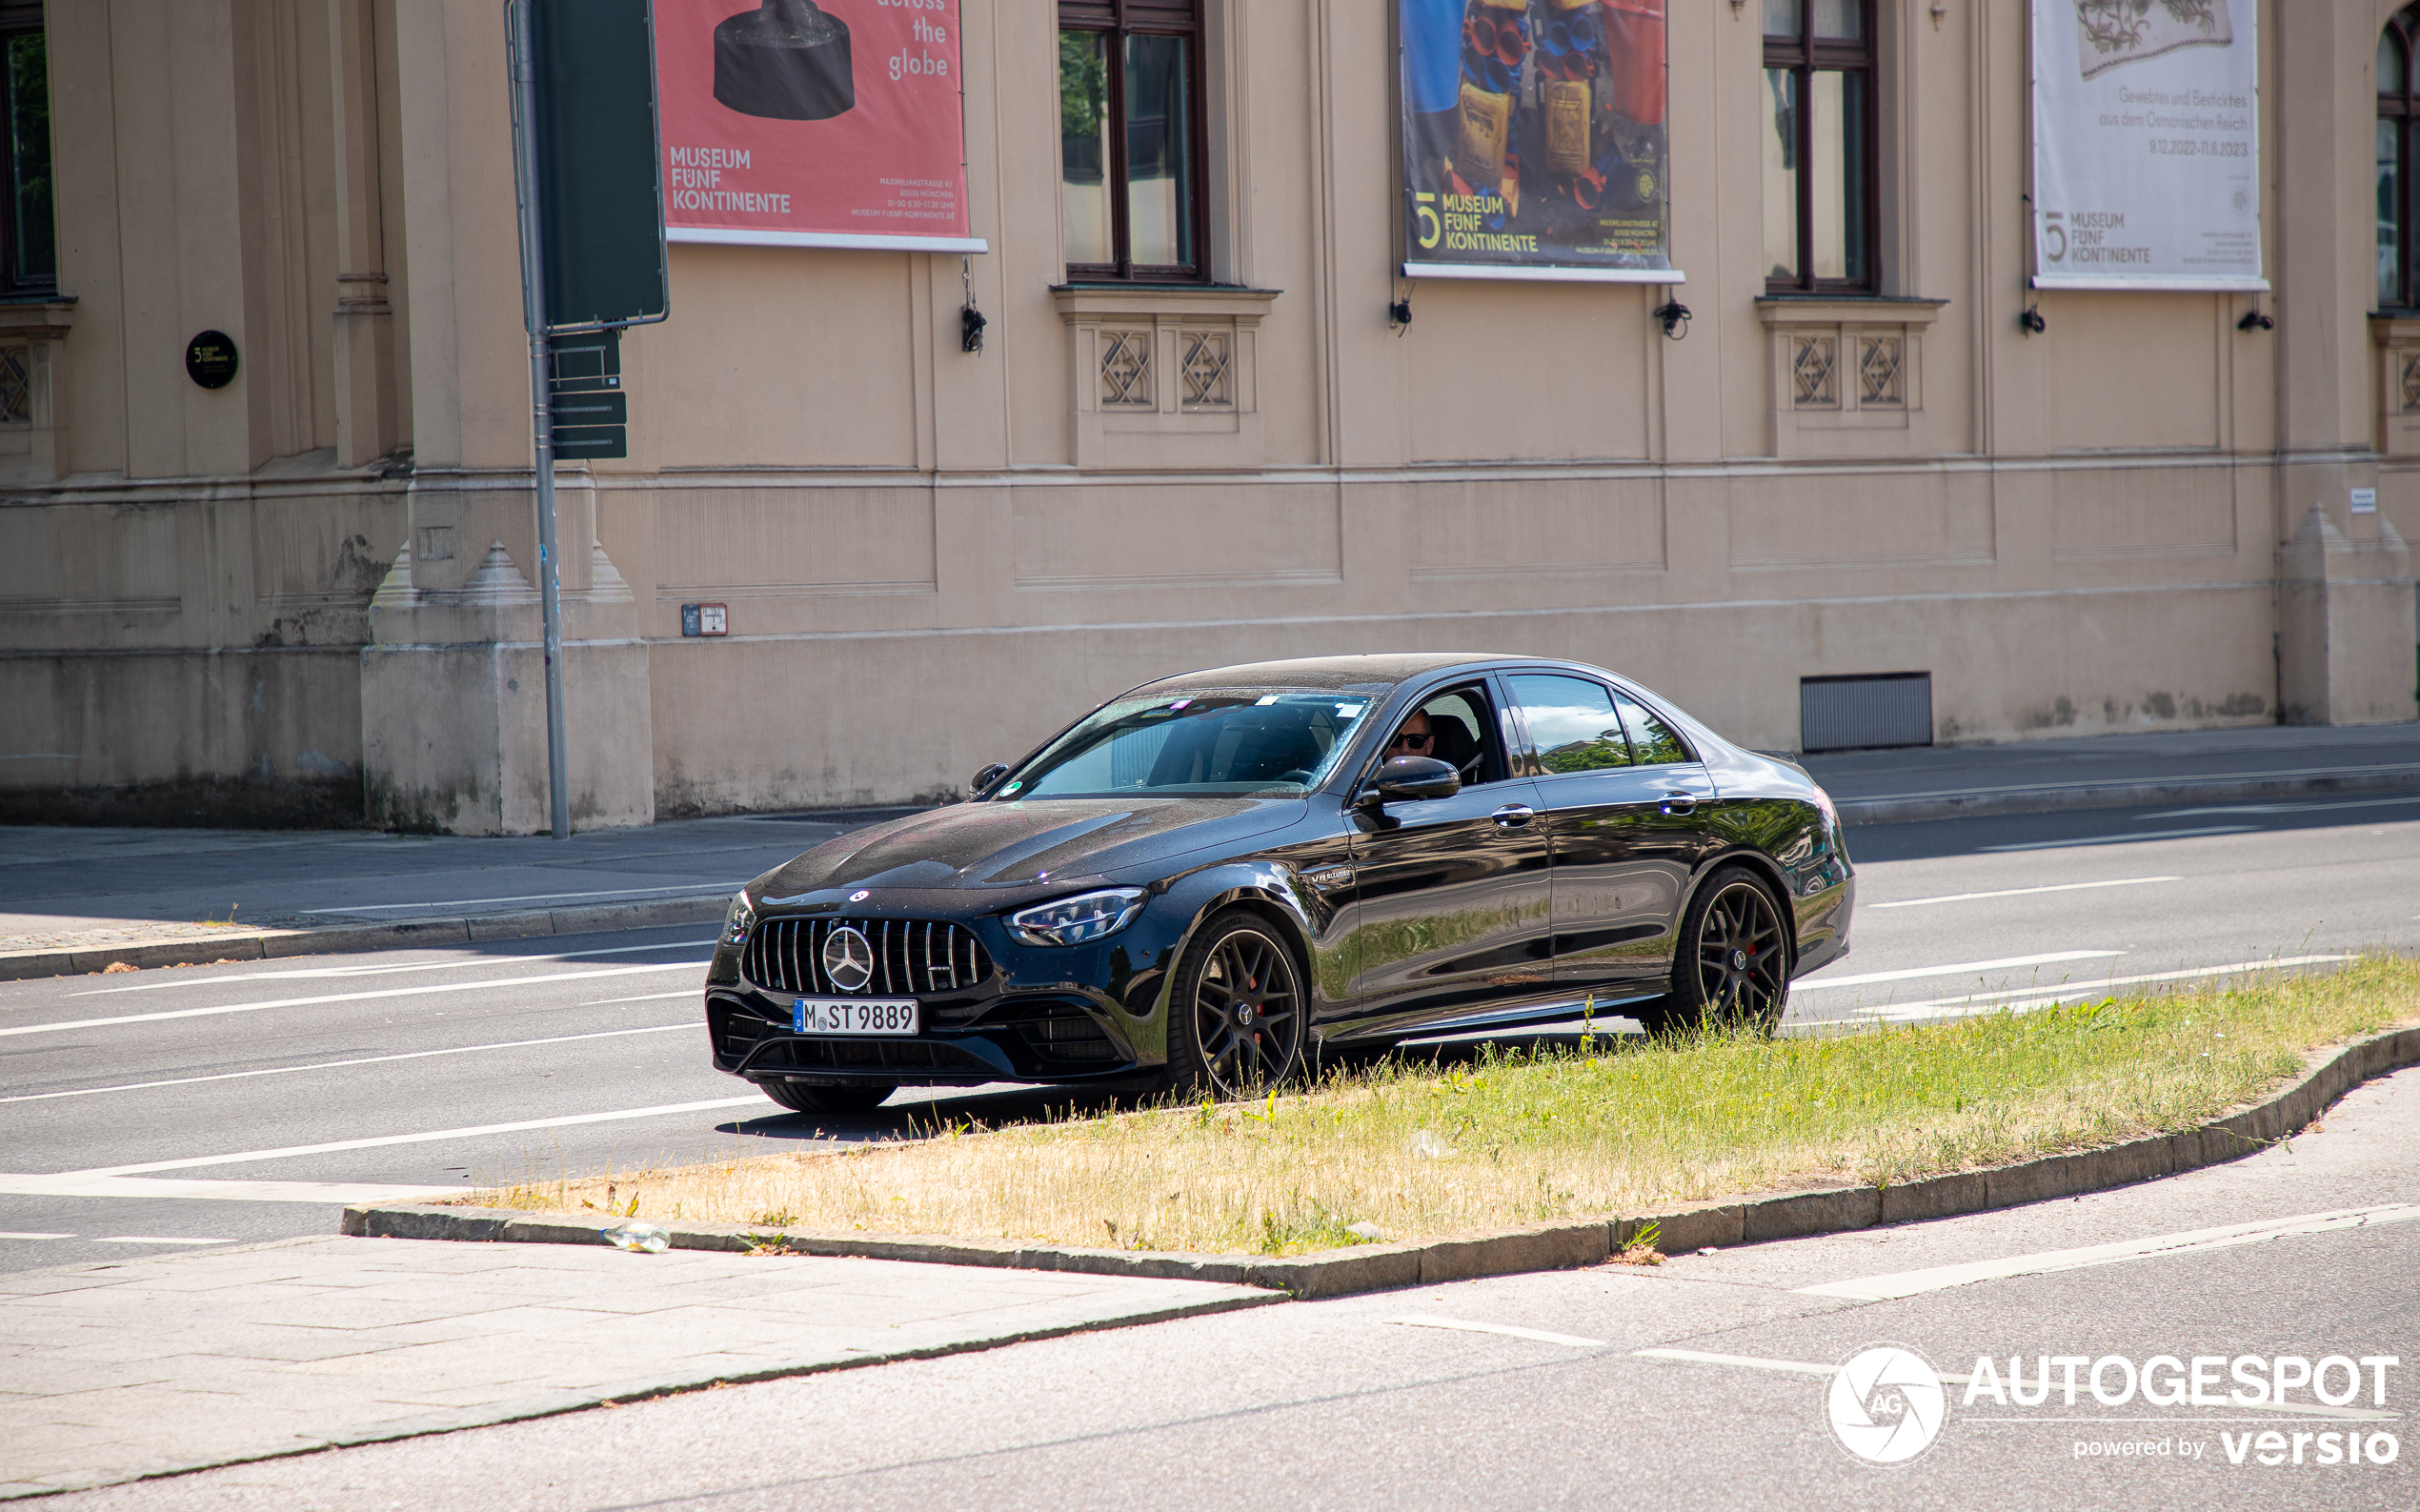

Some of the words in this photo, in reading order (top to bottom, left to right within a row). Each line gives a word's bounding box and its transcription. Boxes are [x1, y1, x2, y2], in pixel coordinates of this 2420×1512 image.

[912, 16, 947, 44] the
[889, 48, 948, 81] globe
[2119, 85, 2169, 105] Gewebtes
[2171, 90, 2190, 106] und
[2192, 90, 2248, 108] Besticktes
[2099, 113, 2120, 127] aus
[2121, 110, 2144, 127] dem
[2146, 111, 2215, 130] Osmanischen
[2216, 113, 2248, 131] Reich
[670, 146, 751, 170] MUSEUM
[672, 168, 721, 189] FÜNF
[879, 177, 943, 188] MAXIMILIANSTRASSE
[944, 179, 953, 188] 42
[673, 190, 791, 213] KONTINENTE
[920, 190, 954, 198] MÜNCHEN
[1442, 193, 1503, 214] MUSEUM
[1416, 192, 1441, 249] 5
[1444, 212, 1482, 232] FÜNF
[2070, 212, 2125, 229] MUSEUM
[1446, 232, 1539, 252] KONTINENTE
[2046, 212, 2067, 263] 5
[2072, 247, 2150, 264] KONTINENTE
[1311, 874, 1326, 882] V8
[797, 1018, 802, 1027] D
[804, 1004, 817, 1029] M
[828, 1005, 854, 1030] ST
[857, 1005, 914, 1030] 9889
